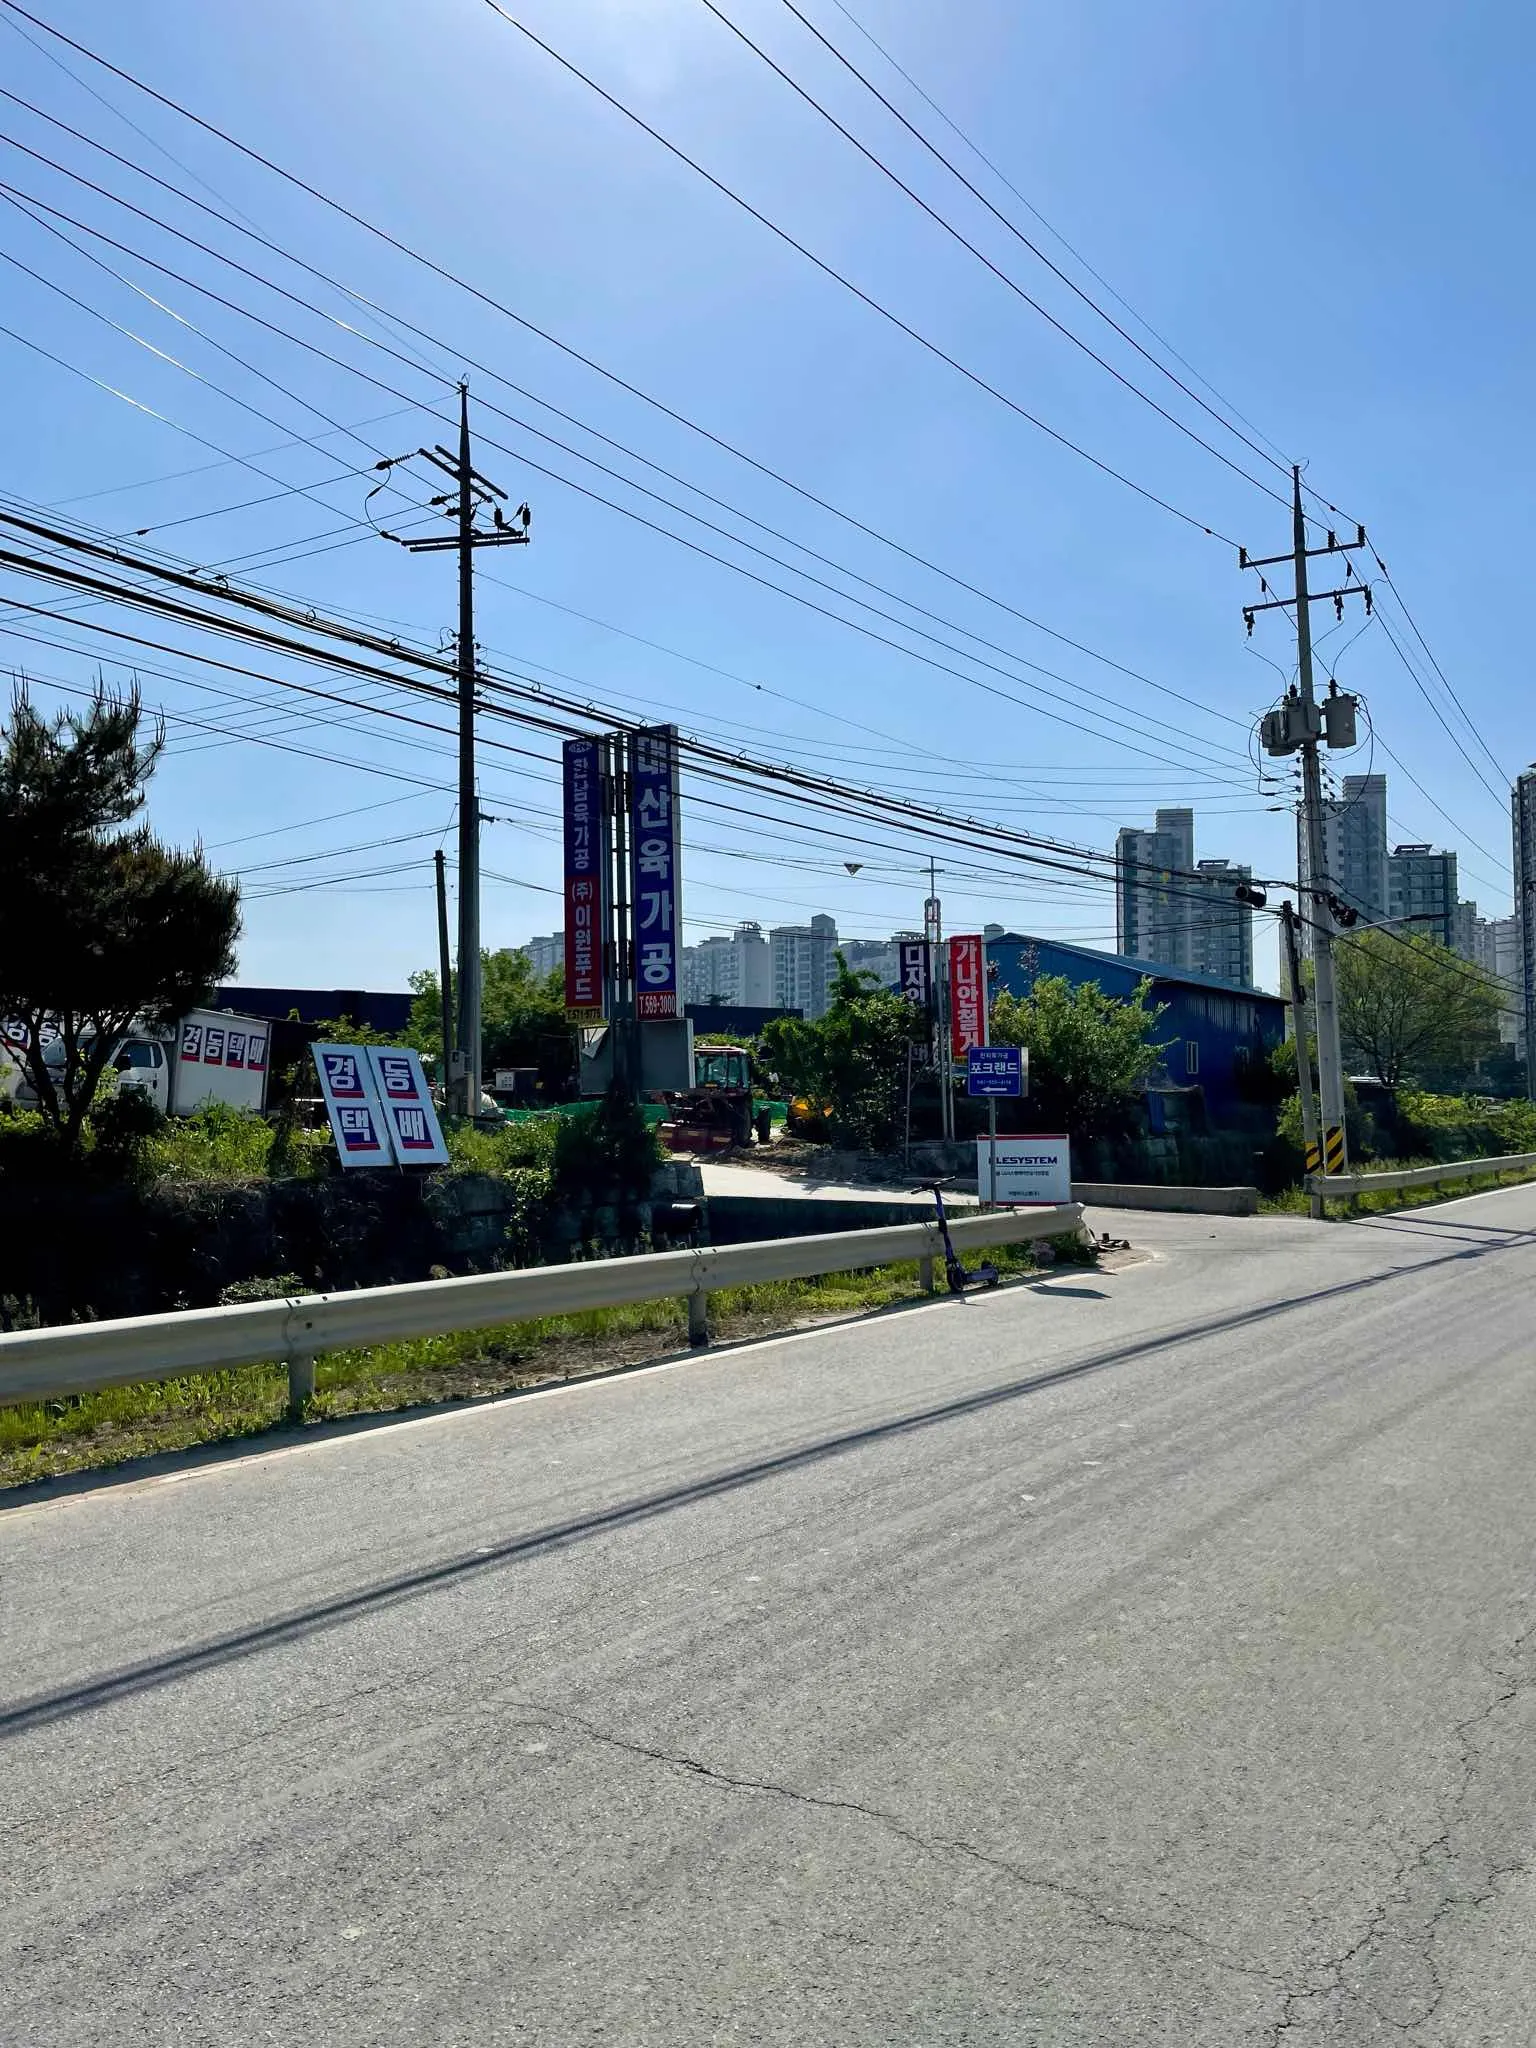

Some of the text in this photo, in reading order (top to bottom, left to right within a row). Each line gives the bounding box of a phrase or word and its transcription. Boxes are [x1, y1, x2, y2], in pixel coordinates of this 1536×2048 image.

[182, 1026, 266, 1064] 경동택배
[970, 1062, 1018, 1075] 포크랜드
[988, 1155, 1058, 1165] LESYSTEM
